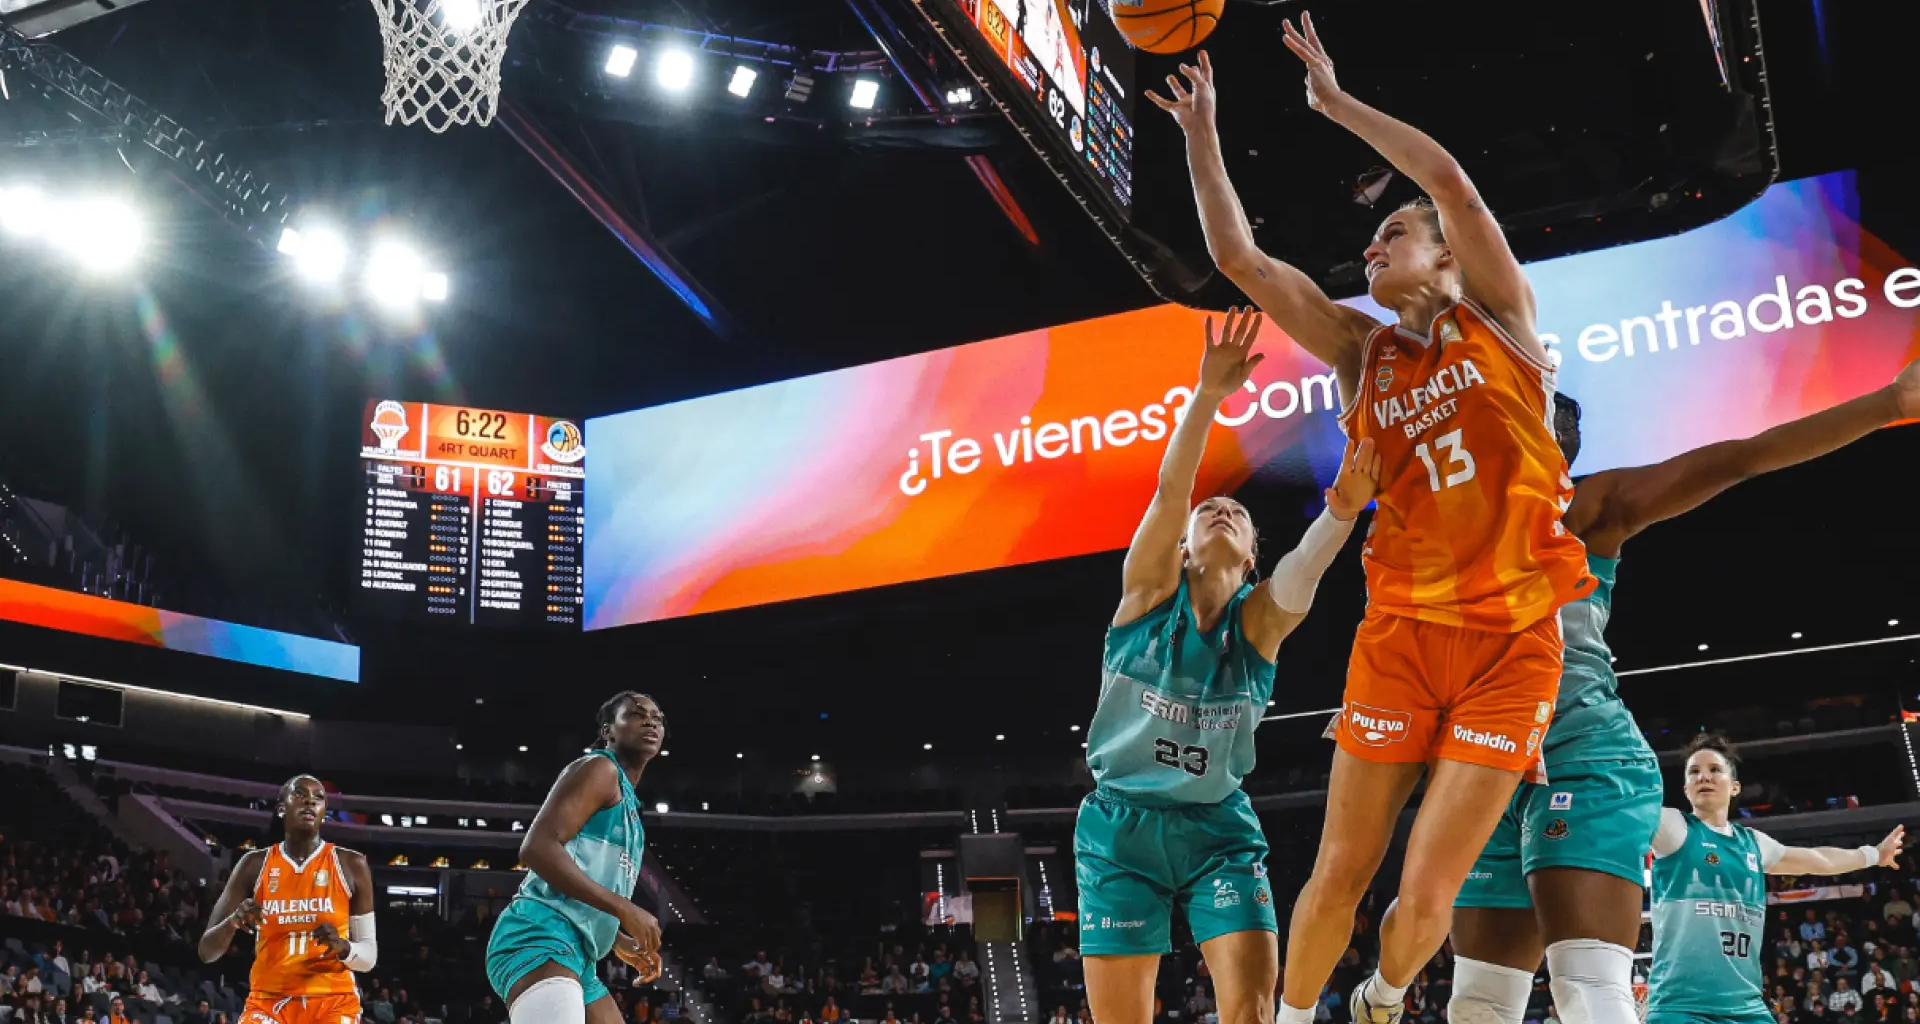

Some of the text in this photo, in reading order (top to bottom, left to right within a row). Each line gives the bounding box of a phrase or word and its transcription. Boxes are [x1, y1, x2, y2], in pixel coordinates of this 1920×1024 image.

[1048, 87, 1065, 129] 62
[899, 430, 981, 496] ¿Te
[994, 386, 1195, 468] vienes?
[1577, 275, 1868, 363] entradas
[1373, 359, 1486, 429] VALENCIA
[456, 409, 507, 440] 6:22
[1402, 398, 1458, 439] BASKET
[438, 442, 518, 460] 4RT QUART
[1415, 428, 1476, 492] 13
[434, 465, 461, 492] 61
[487, 470, 515, 496] 62
[1352, 711, 1404, 731] PULEVA
[1453, 723, 1517, 753] Vitaldin
[1154, 737, 1209, 778] 23
[263, 897, 335, 915] VALENCIA
[278, 914, 317, 924] BASKET
[288, 930, 307, 956] 11
[1720, 929, 1751, 958] 20
